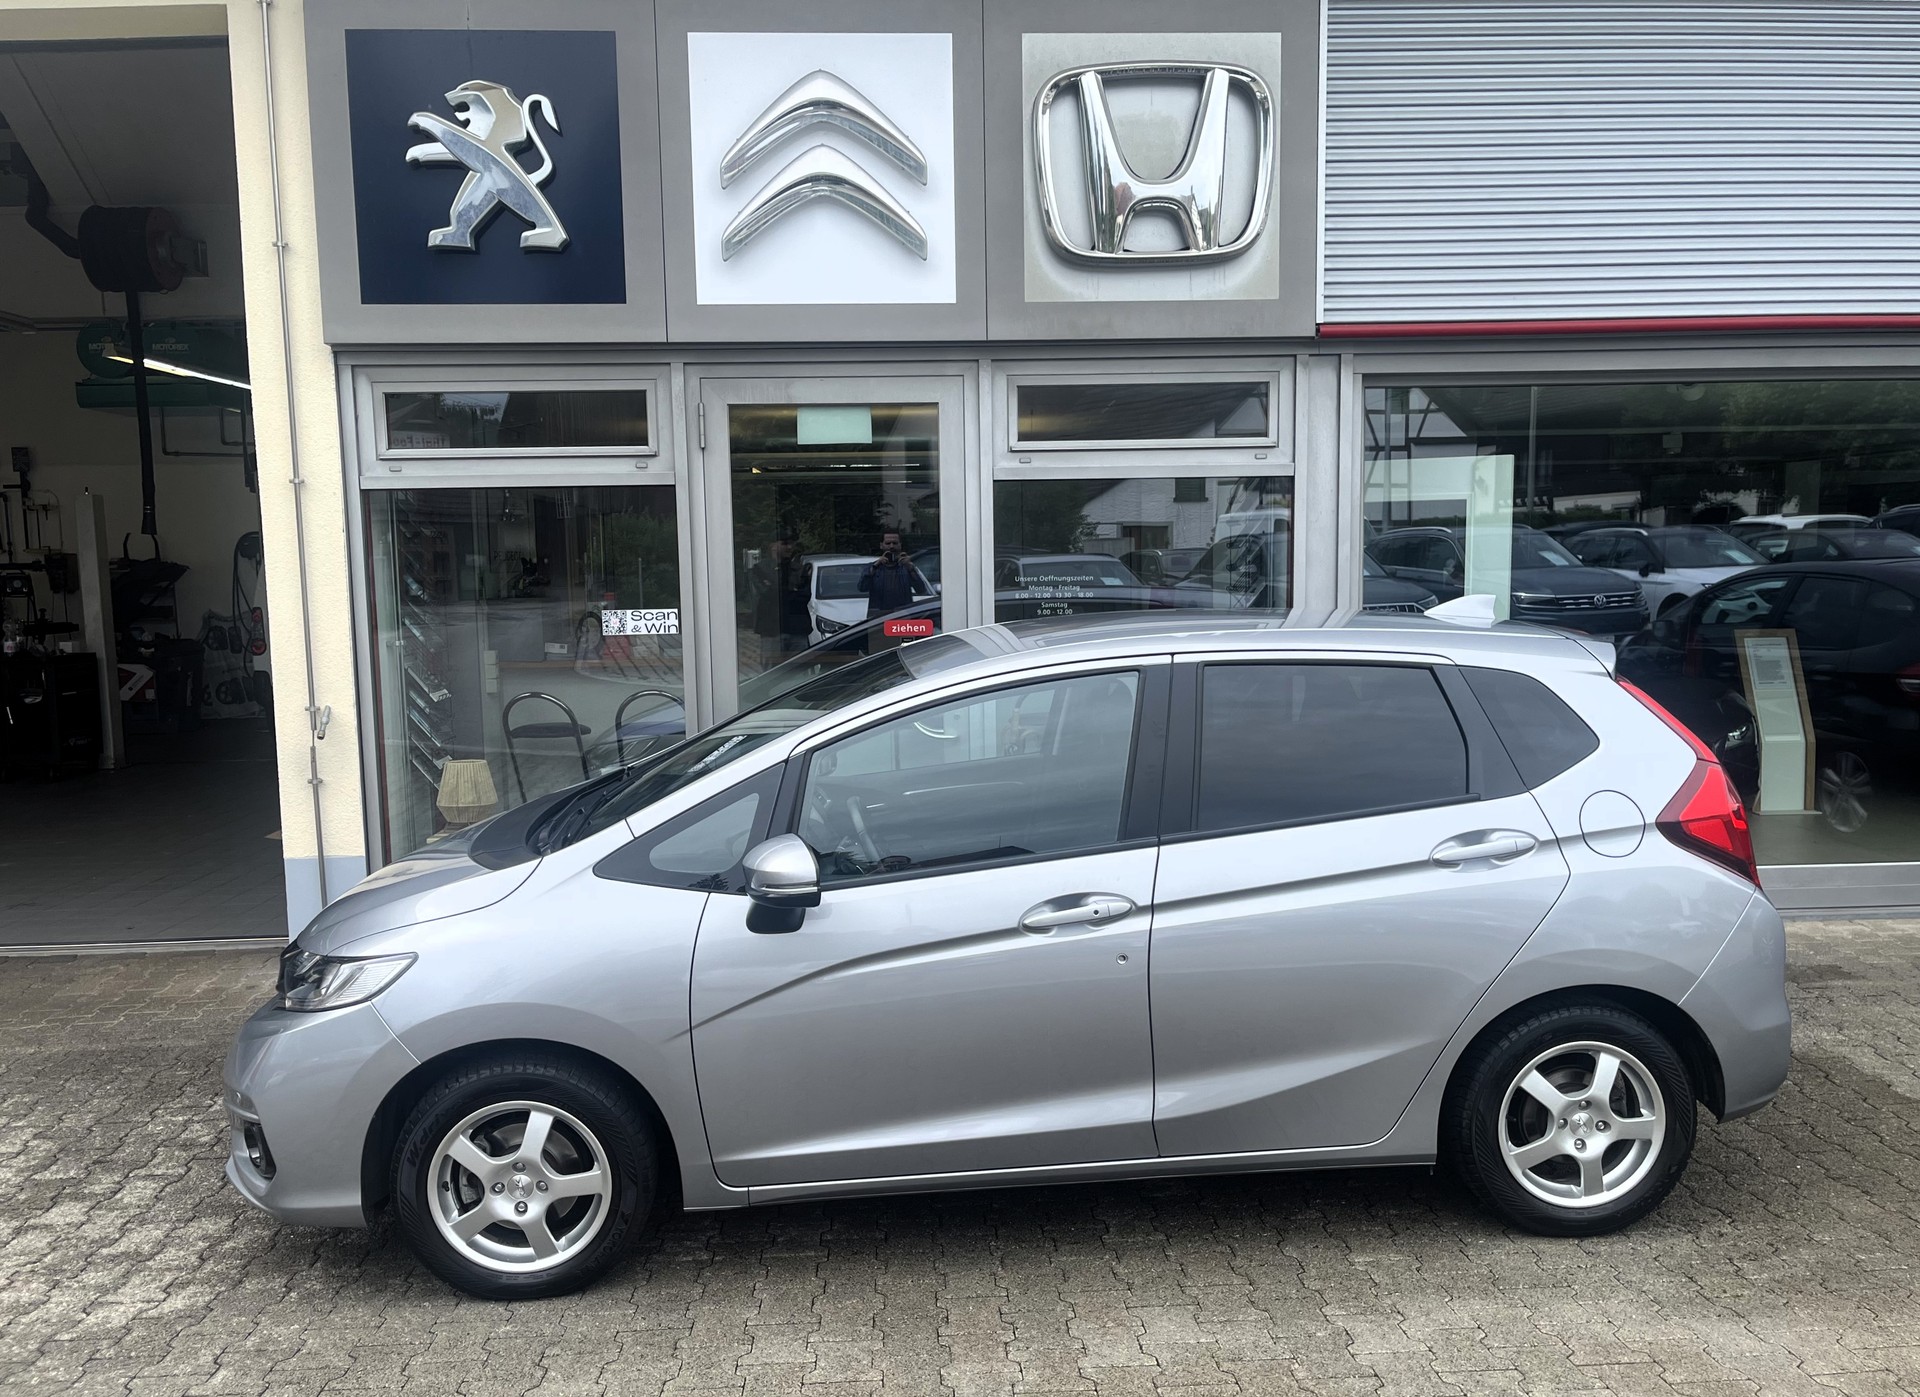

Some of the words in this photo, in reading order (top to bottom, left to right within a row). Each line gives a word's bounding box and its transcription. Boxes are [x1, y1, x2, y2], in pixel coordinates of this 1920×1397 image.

[152, 343, 189, 351] MOTOREX
[631, 610, 678, 621] Scan
[631, 624, 642, 633] &
[644, 621, 679, 634] Win
[891, 624, 926, 633] ziehen
